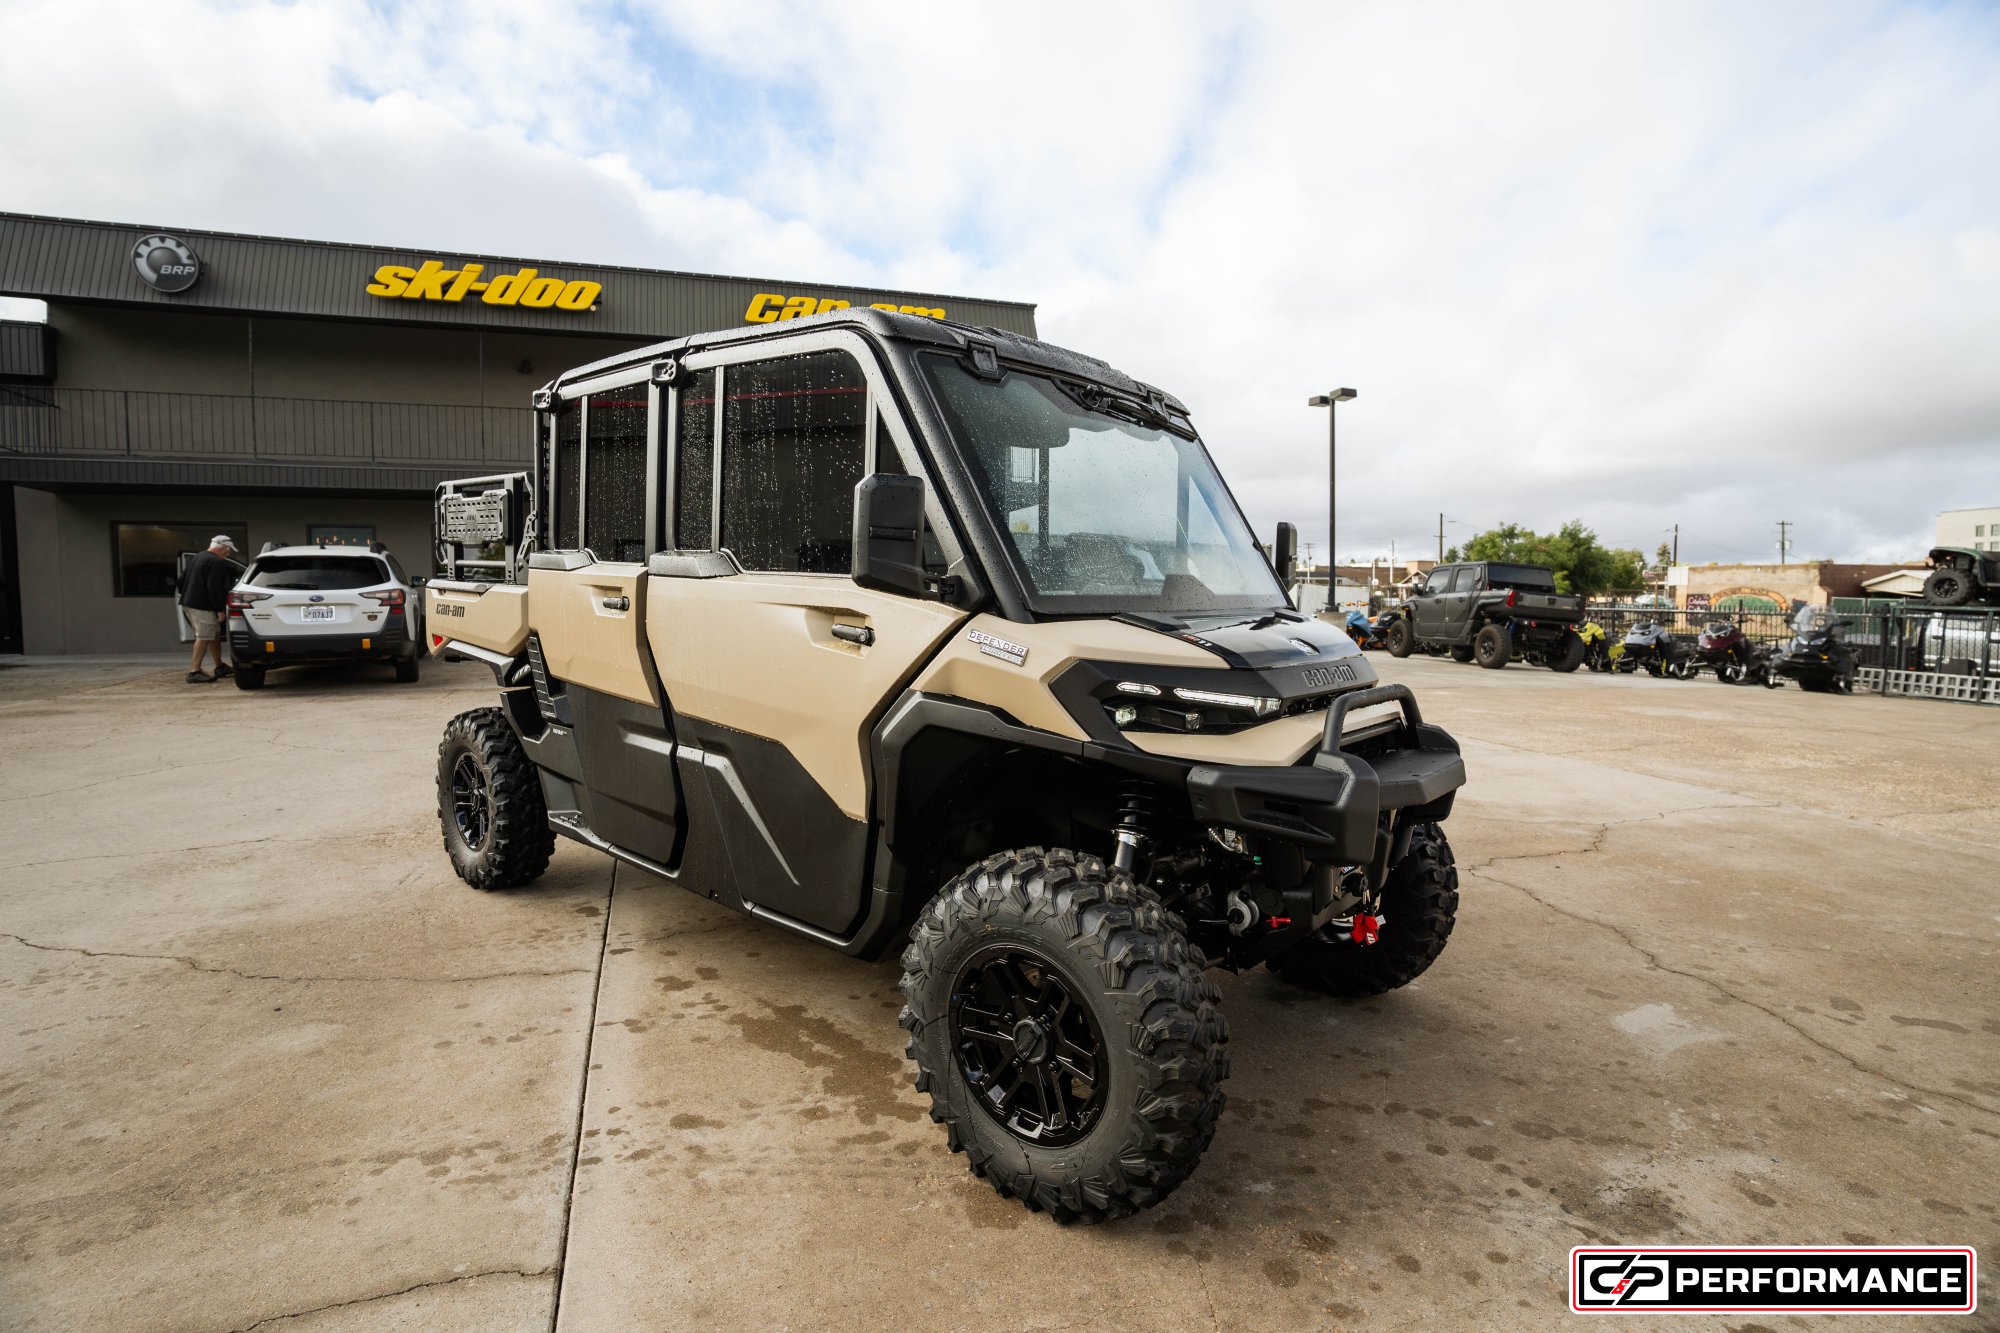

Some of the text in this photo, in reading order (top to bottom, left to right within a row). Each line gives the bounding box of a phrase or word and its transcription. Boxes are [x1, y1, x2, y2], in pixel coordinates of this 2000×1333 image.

[160, 264, 195, 275] BRP
[366, 260, 602, 312] ski-doo
[436, 603, 465, 618] can-am
[969, 631, 1025, 657] DEFENDER
[1302, 664, 1357, 687] can-am
